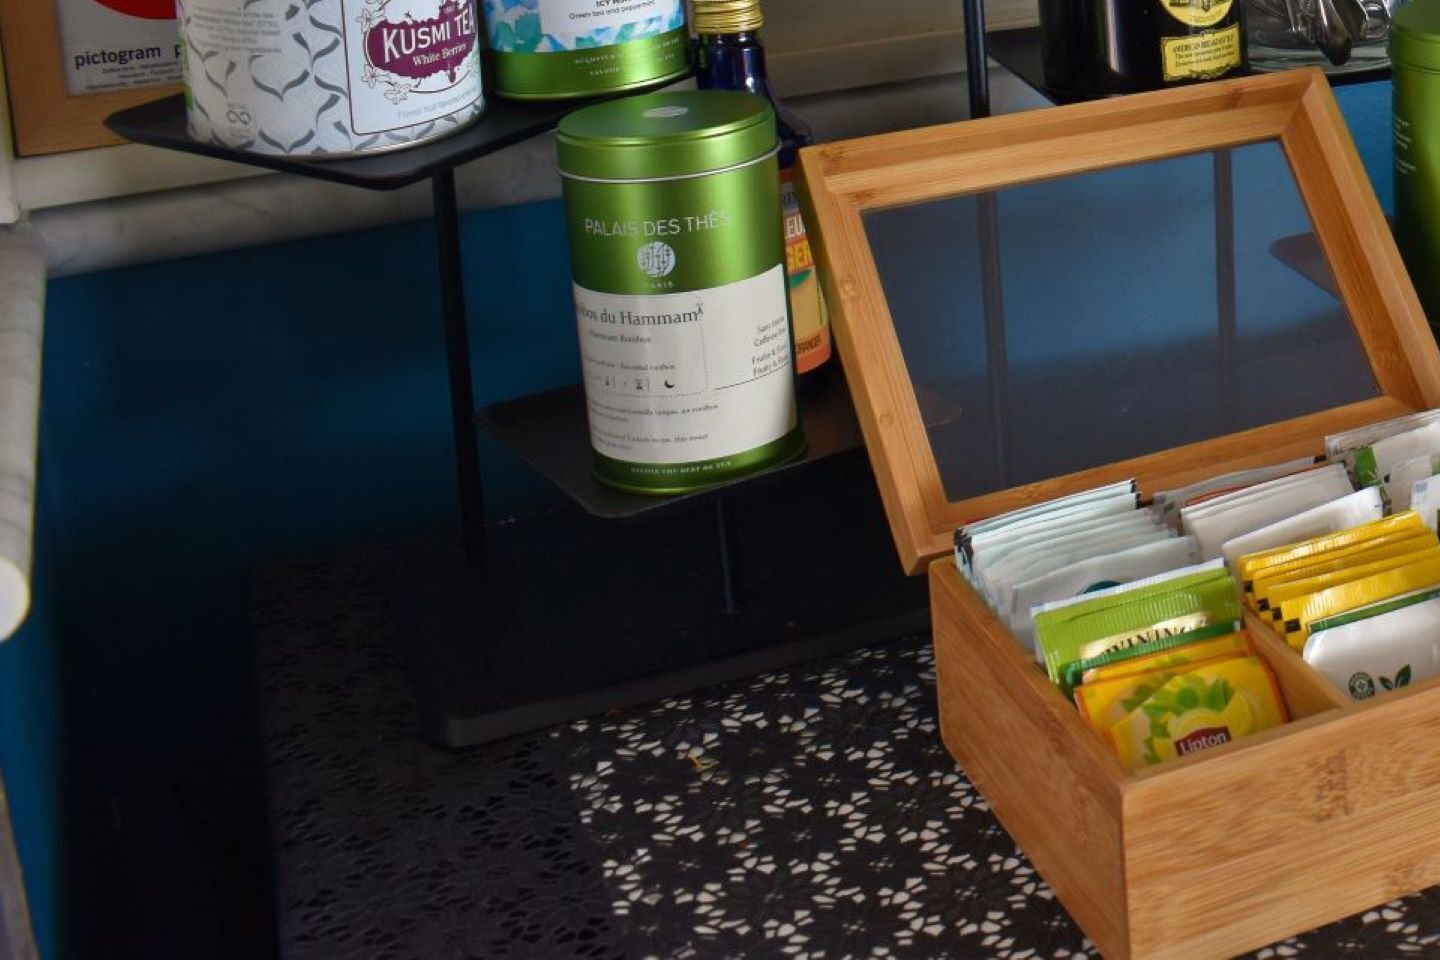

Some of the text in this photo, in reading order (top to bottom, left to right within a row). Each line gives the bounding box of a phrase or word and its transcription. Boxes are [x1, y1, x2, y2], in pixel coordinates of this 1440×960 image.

[596, 0, 610, 7] ICY
[382, 3, 476, 64] KUSMI TEA
[75, 47, 161, 70] pictogram
[413, 43, 467, 66] White Berries
[584, 218, 640, 236] PALAIS
[643, 218, 680, 236] DES
[601, 308, 616, 325] du
[620, 310, 699, 326] Hammam
[1180, 732, 1226, 755] Lipton
